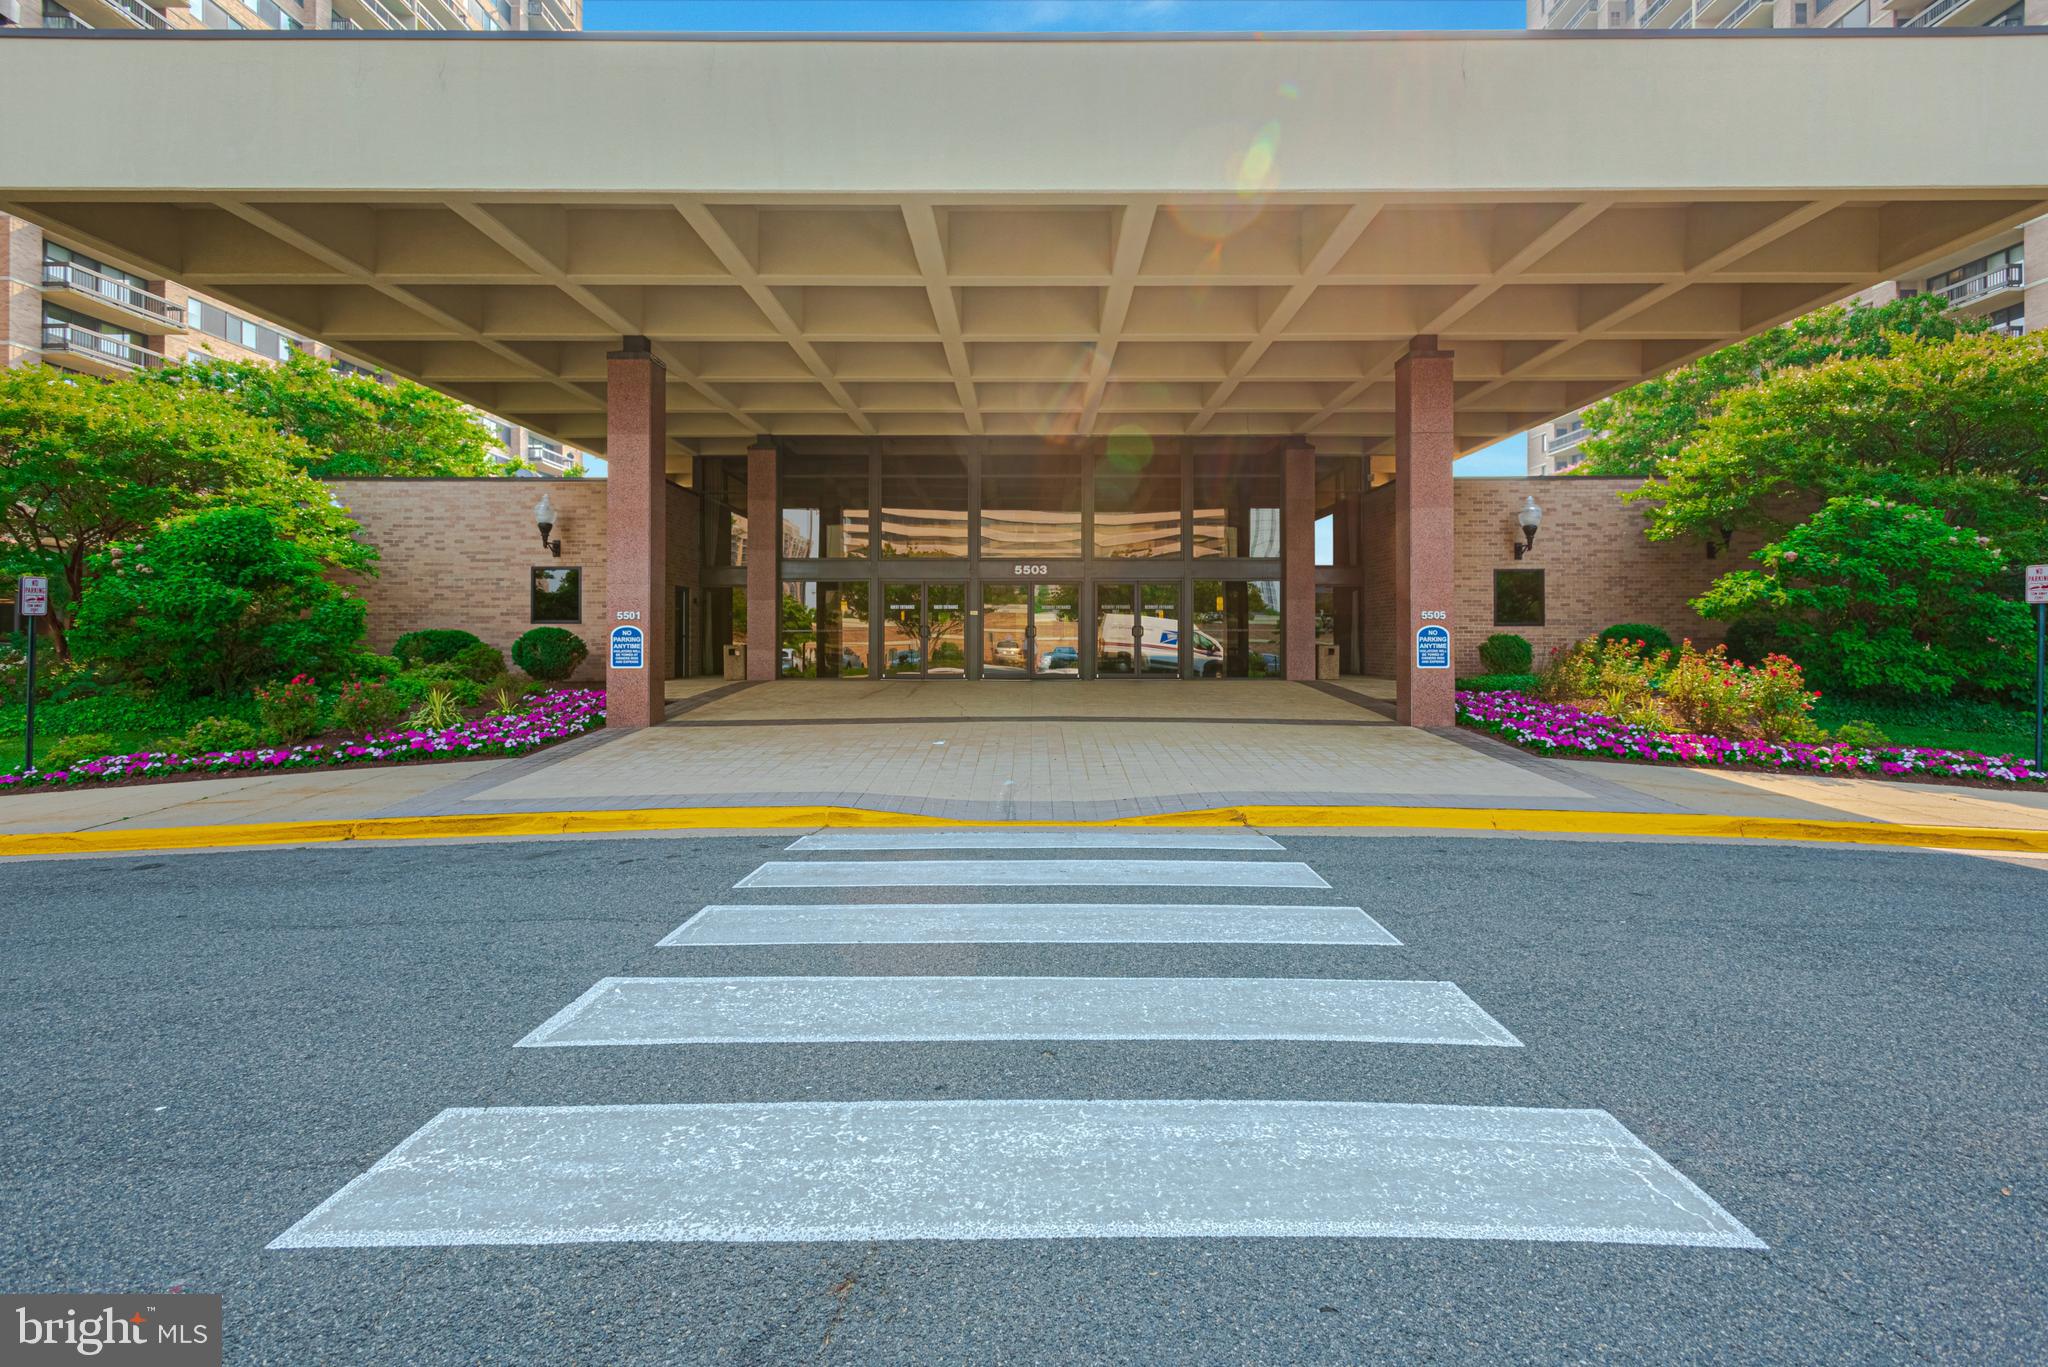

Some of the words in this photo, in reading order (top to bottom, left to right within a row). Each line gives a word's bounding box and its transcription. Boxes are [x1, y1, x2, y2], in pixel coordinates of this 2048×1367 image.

[1015, 565, 1047, 575] 5503
[617, 611, 640, 620] 5501
[1421, 611, 1446, 620] 5505
